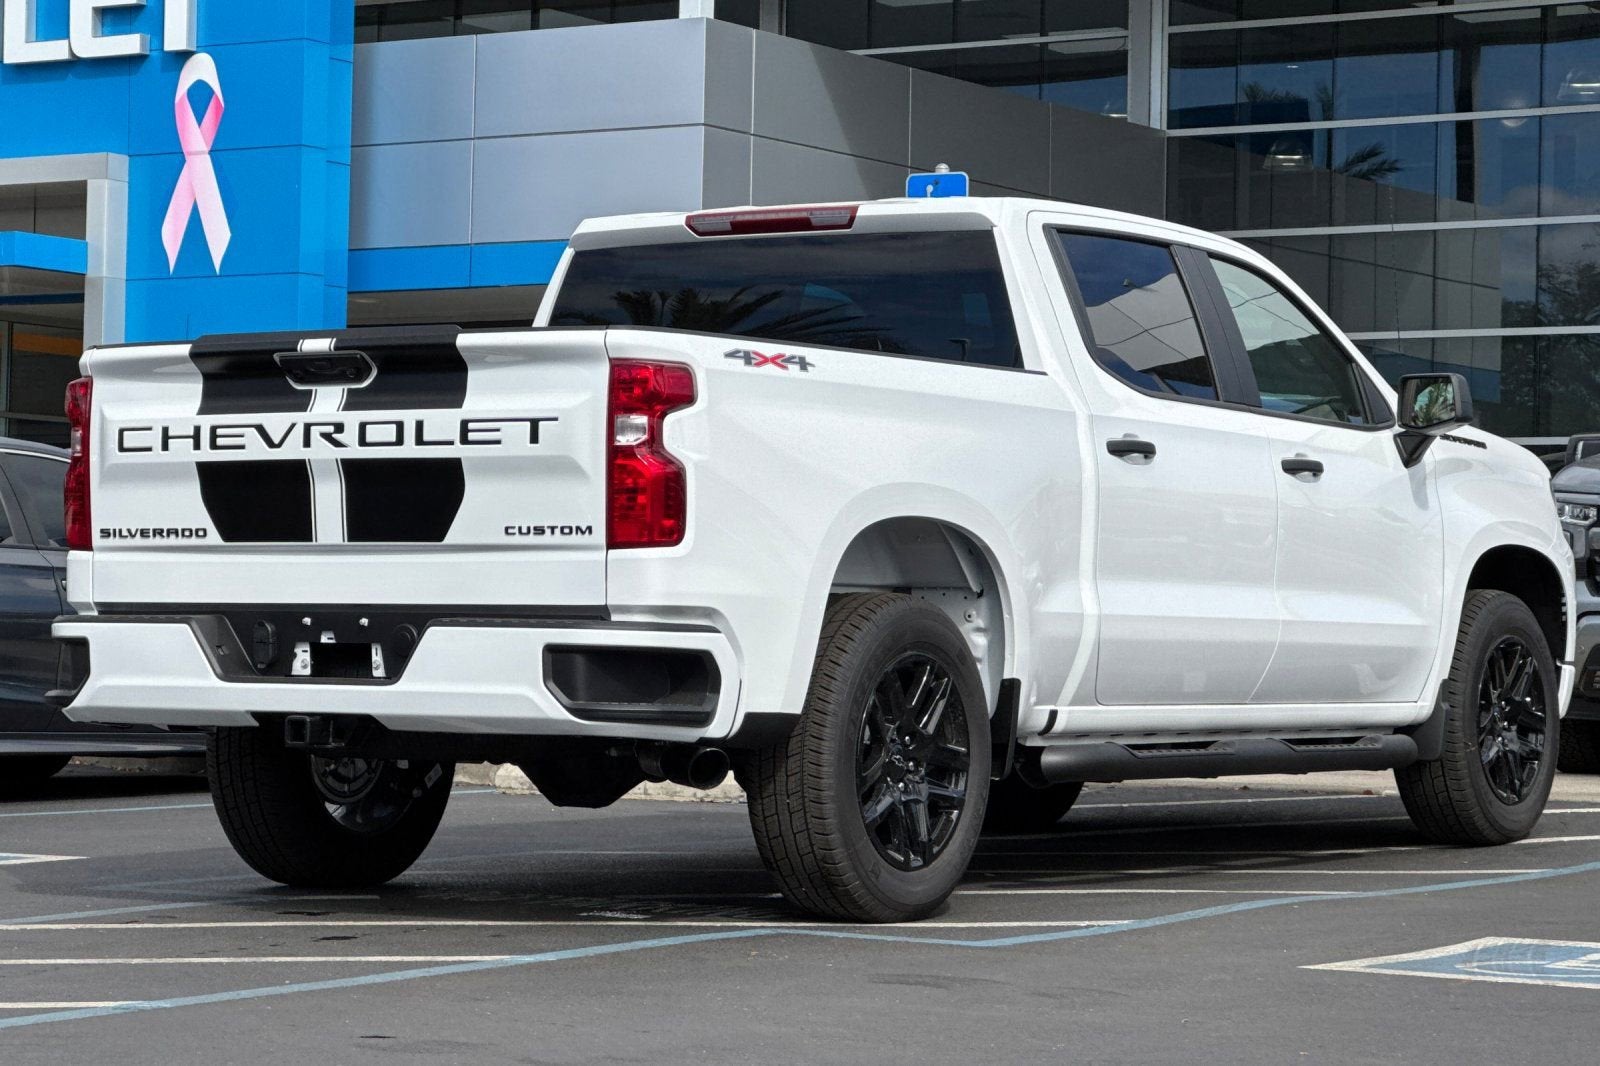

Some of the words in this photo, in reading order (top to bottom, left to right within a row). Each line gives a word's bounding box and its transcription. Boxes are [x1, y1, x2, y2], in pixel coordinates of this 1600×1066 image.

[118, 417, 558, 453] CHEVROLET
[99, 528, 208, 539] SILVERADO
[504, 525, 593, 536] CUSTOM
